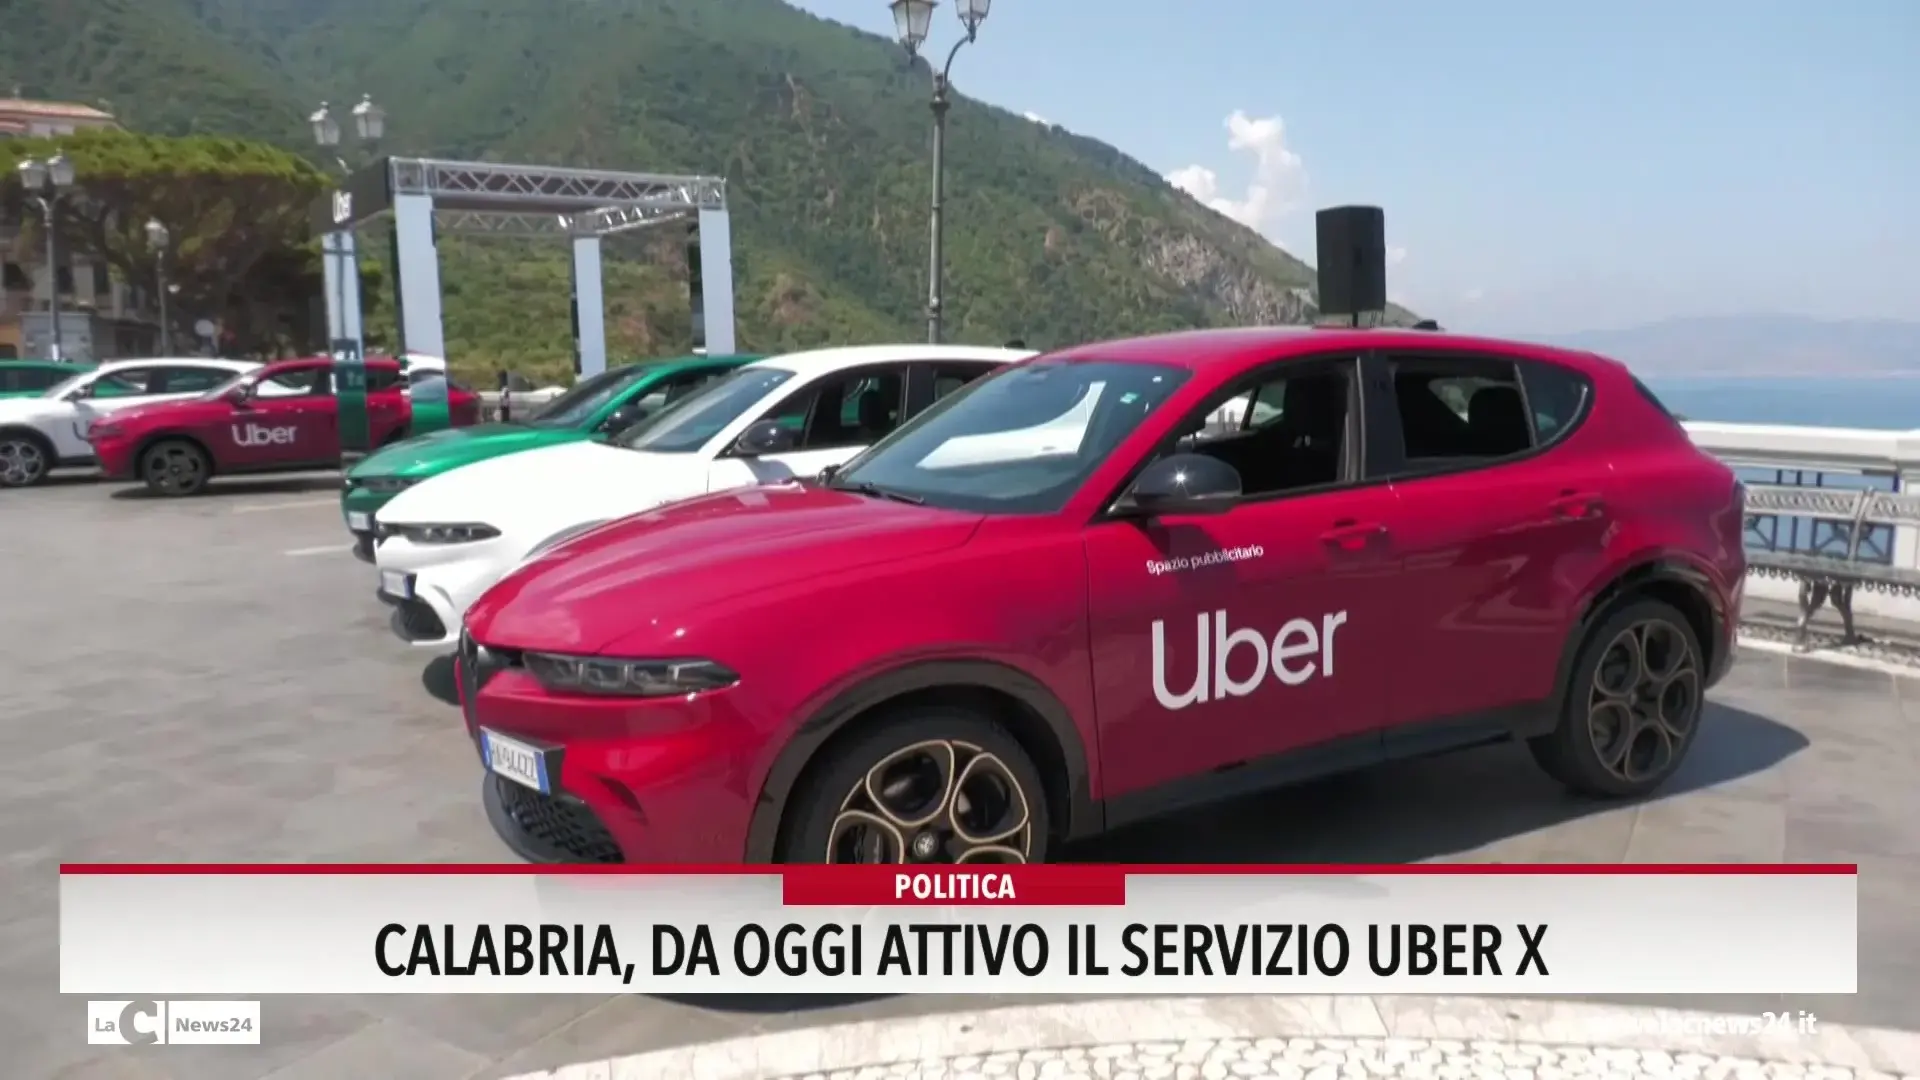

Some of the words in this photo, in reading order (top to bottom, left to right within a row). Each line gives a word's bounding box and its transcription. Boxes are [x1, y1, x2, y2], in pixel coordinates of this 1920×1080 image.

[231, 424, 297, 447] Uber
[1146, 556, 1189, 576] Spazio
[1152, 609, 1347, 710] Uber
